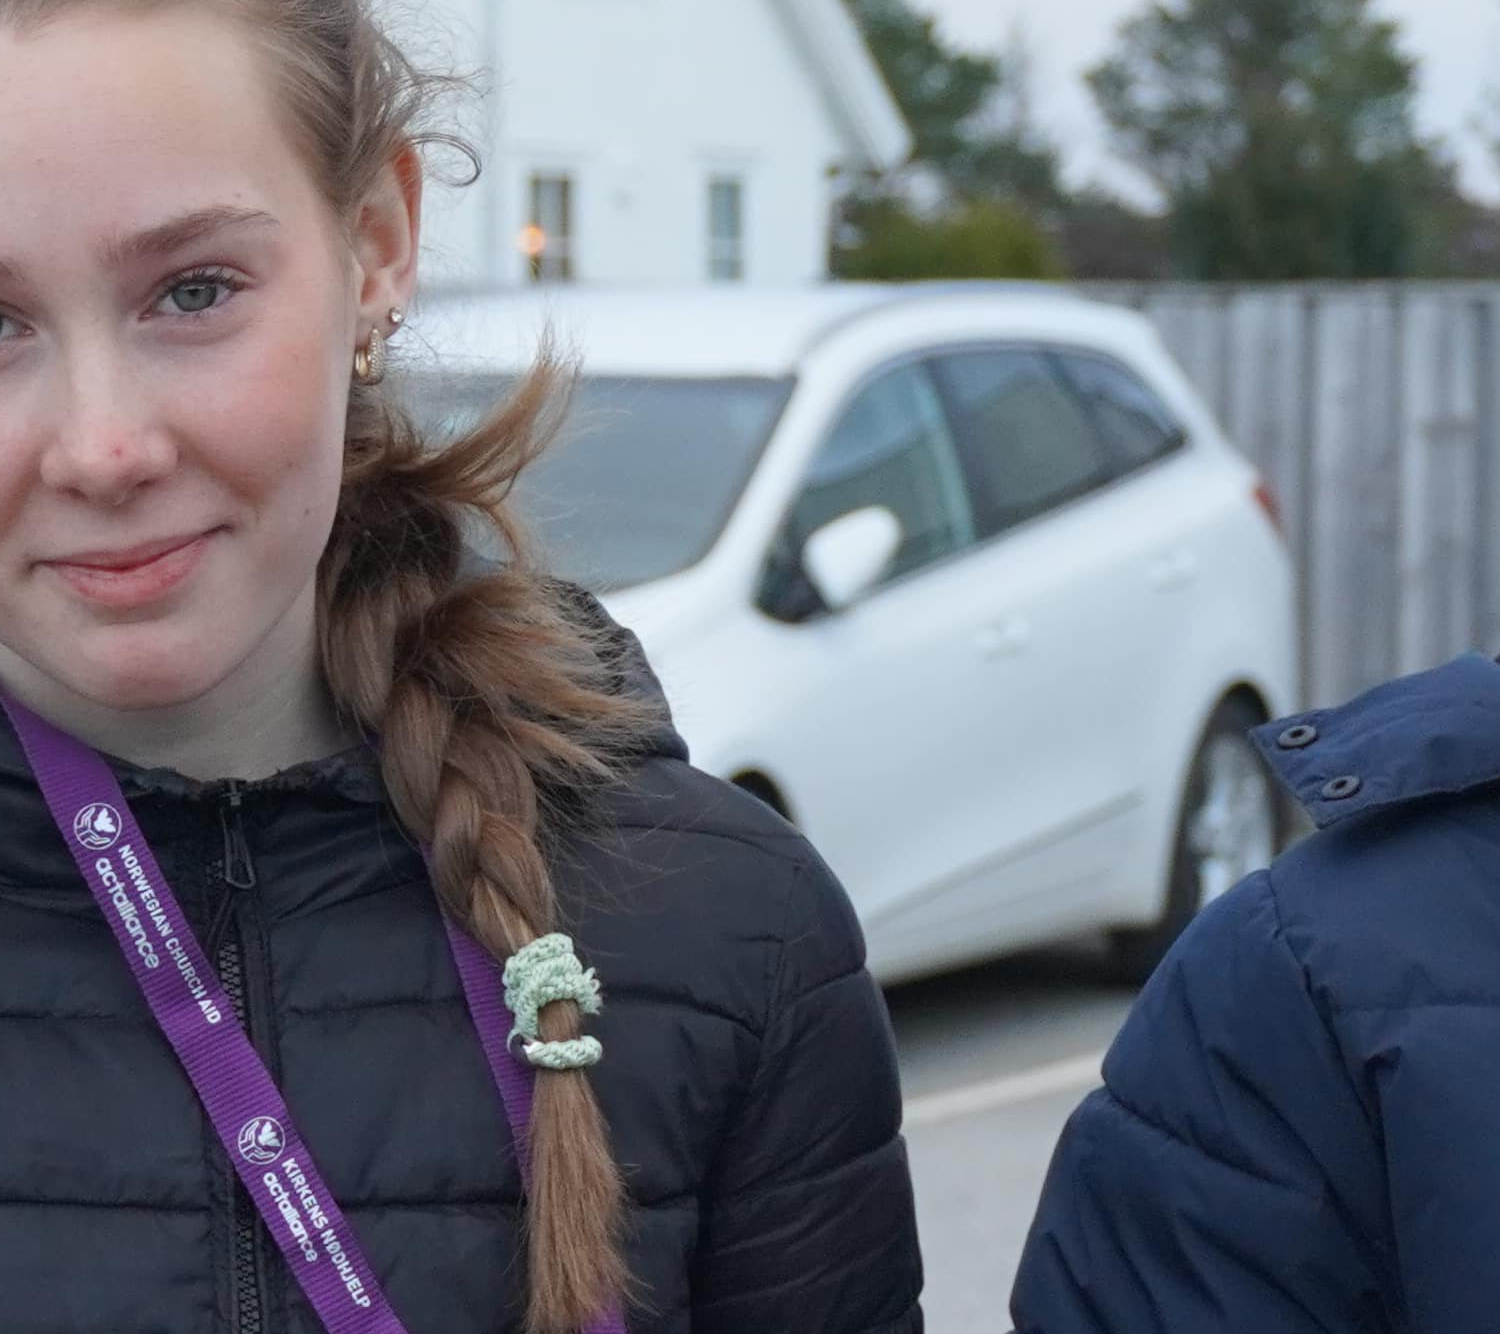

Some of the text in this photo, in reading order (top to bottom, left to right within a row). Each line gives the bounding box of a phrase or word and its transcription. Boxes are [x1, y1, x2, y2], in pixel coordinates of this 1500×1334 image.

[95, 857, 159, 968] actalliance
[118, 844, 222, 1024] NORWEGIAN CHURCH AID
[263, 1172, 318, 1262] actalliance
[282, 1157, 371, 1308] KIRKENS NØDHJELP
